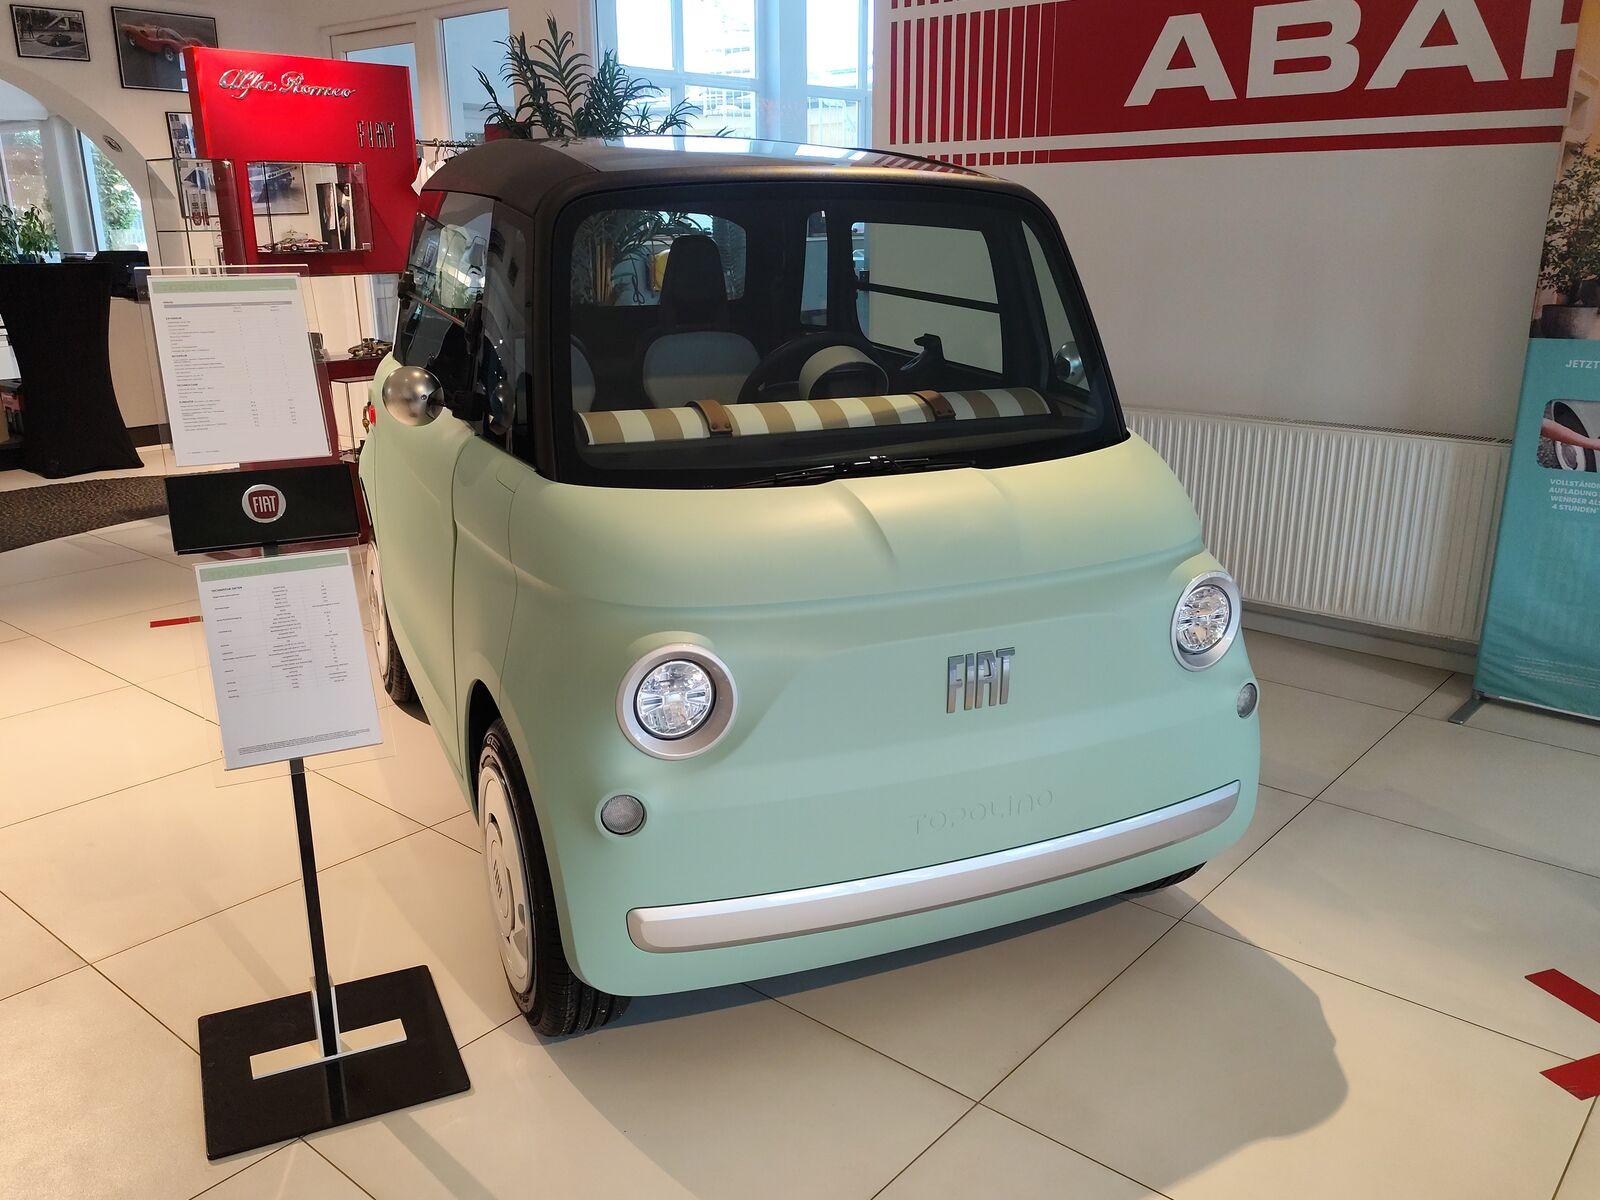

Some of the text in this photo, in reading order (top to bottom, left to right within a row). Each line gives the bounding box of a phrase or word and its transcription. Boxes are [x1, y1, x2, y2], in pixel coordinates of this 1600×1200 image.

[219, 69, 356, 99] Alfa Romeo
[356, 120, 397, 149] FIAT
[1565, 359, 1600, 369] JETZT
[252, 495, 276, 513] FIAT
[946, 647, 1016, 714] FIAT
